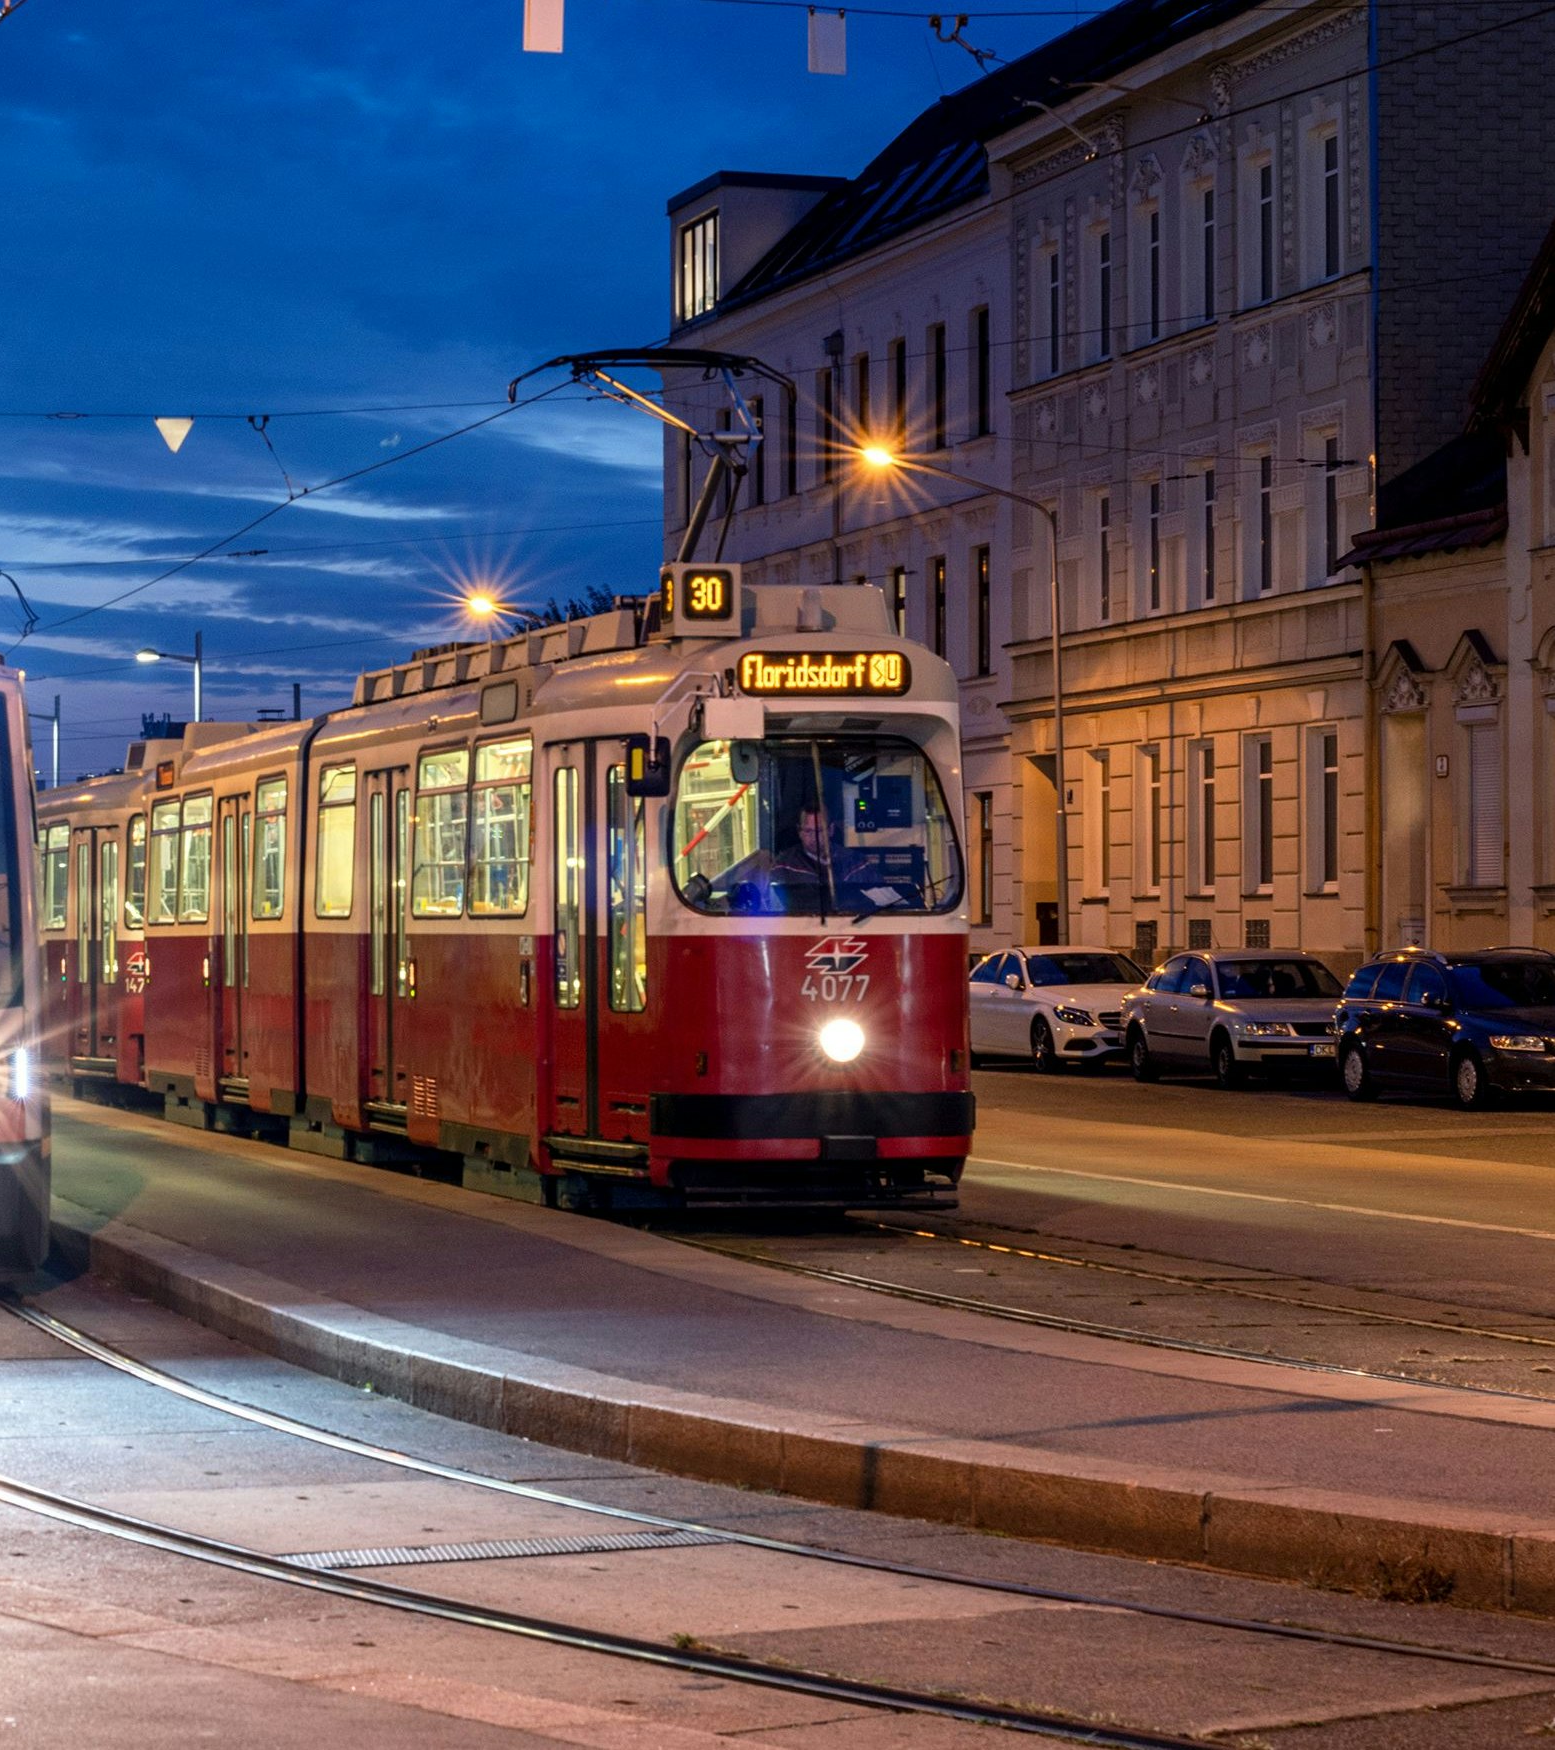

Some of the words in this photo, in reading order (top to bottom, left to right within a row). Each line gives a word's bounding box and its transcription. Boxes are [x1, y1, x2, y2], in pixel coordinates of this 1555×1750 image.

[691, 576, 722, 611] 30
[743, 654, 867, 688] Floridsdorf
[125, 977, 144, 993] 147
[801, 974, 871, 1002] 4077
